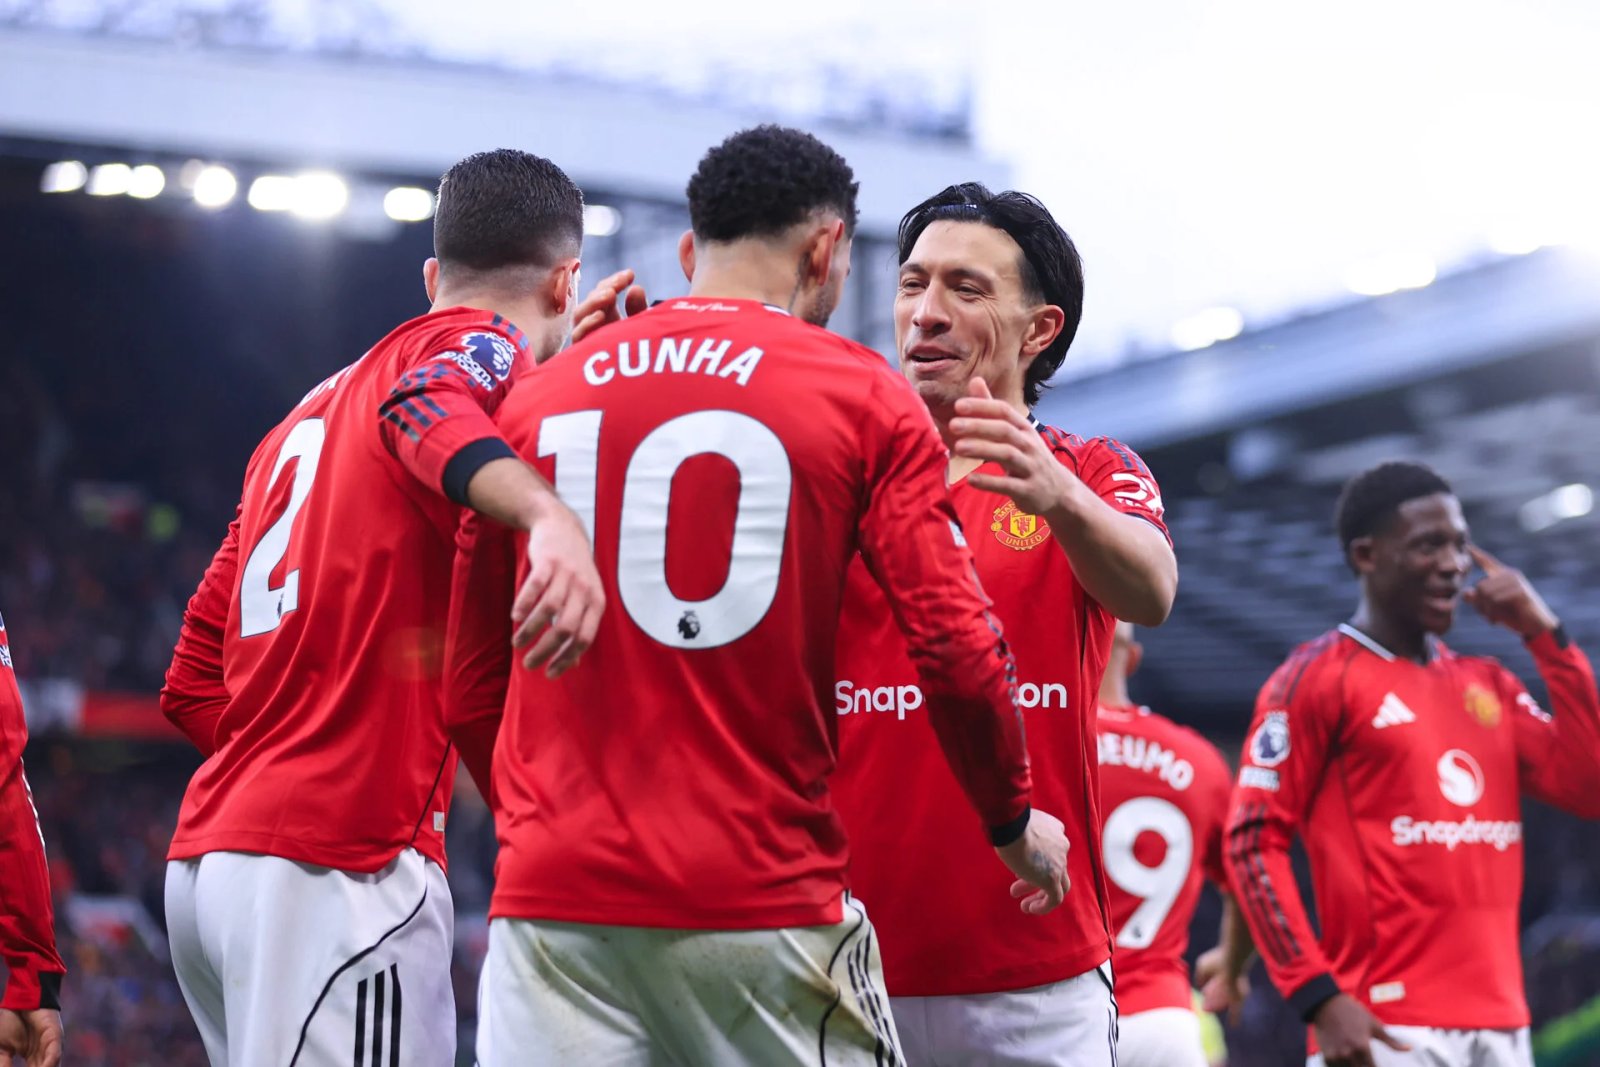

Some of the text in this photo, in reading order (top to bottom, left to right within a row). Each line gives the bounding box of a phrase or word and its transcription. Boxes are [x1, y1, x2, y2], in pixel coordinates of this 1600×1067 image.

[582, 336, 765, 387] CUNHA
[240, 416, 326, 639] 2
[537, 409, 793, 650] 10
[1005, 534, 1042, 547] UNITED
[1103, 796, 1194, 949] 9
